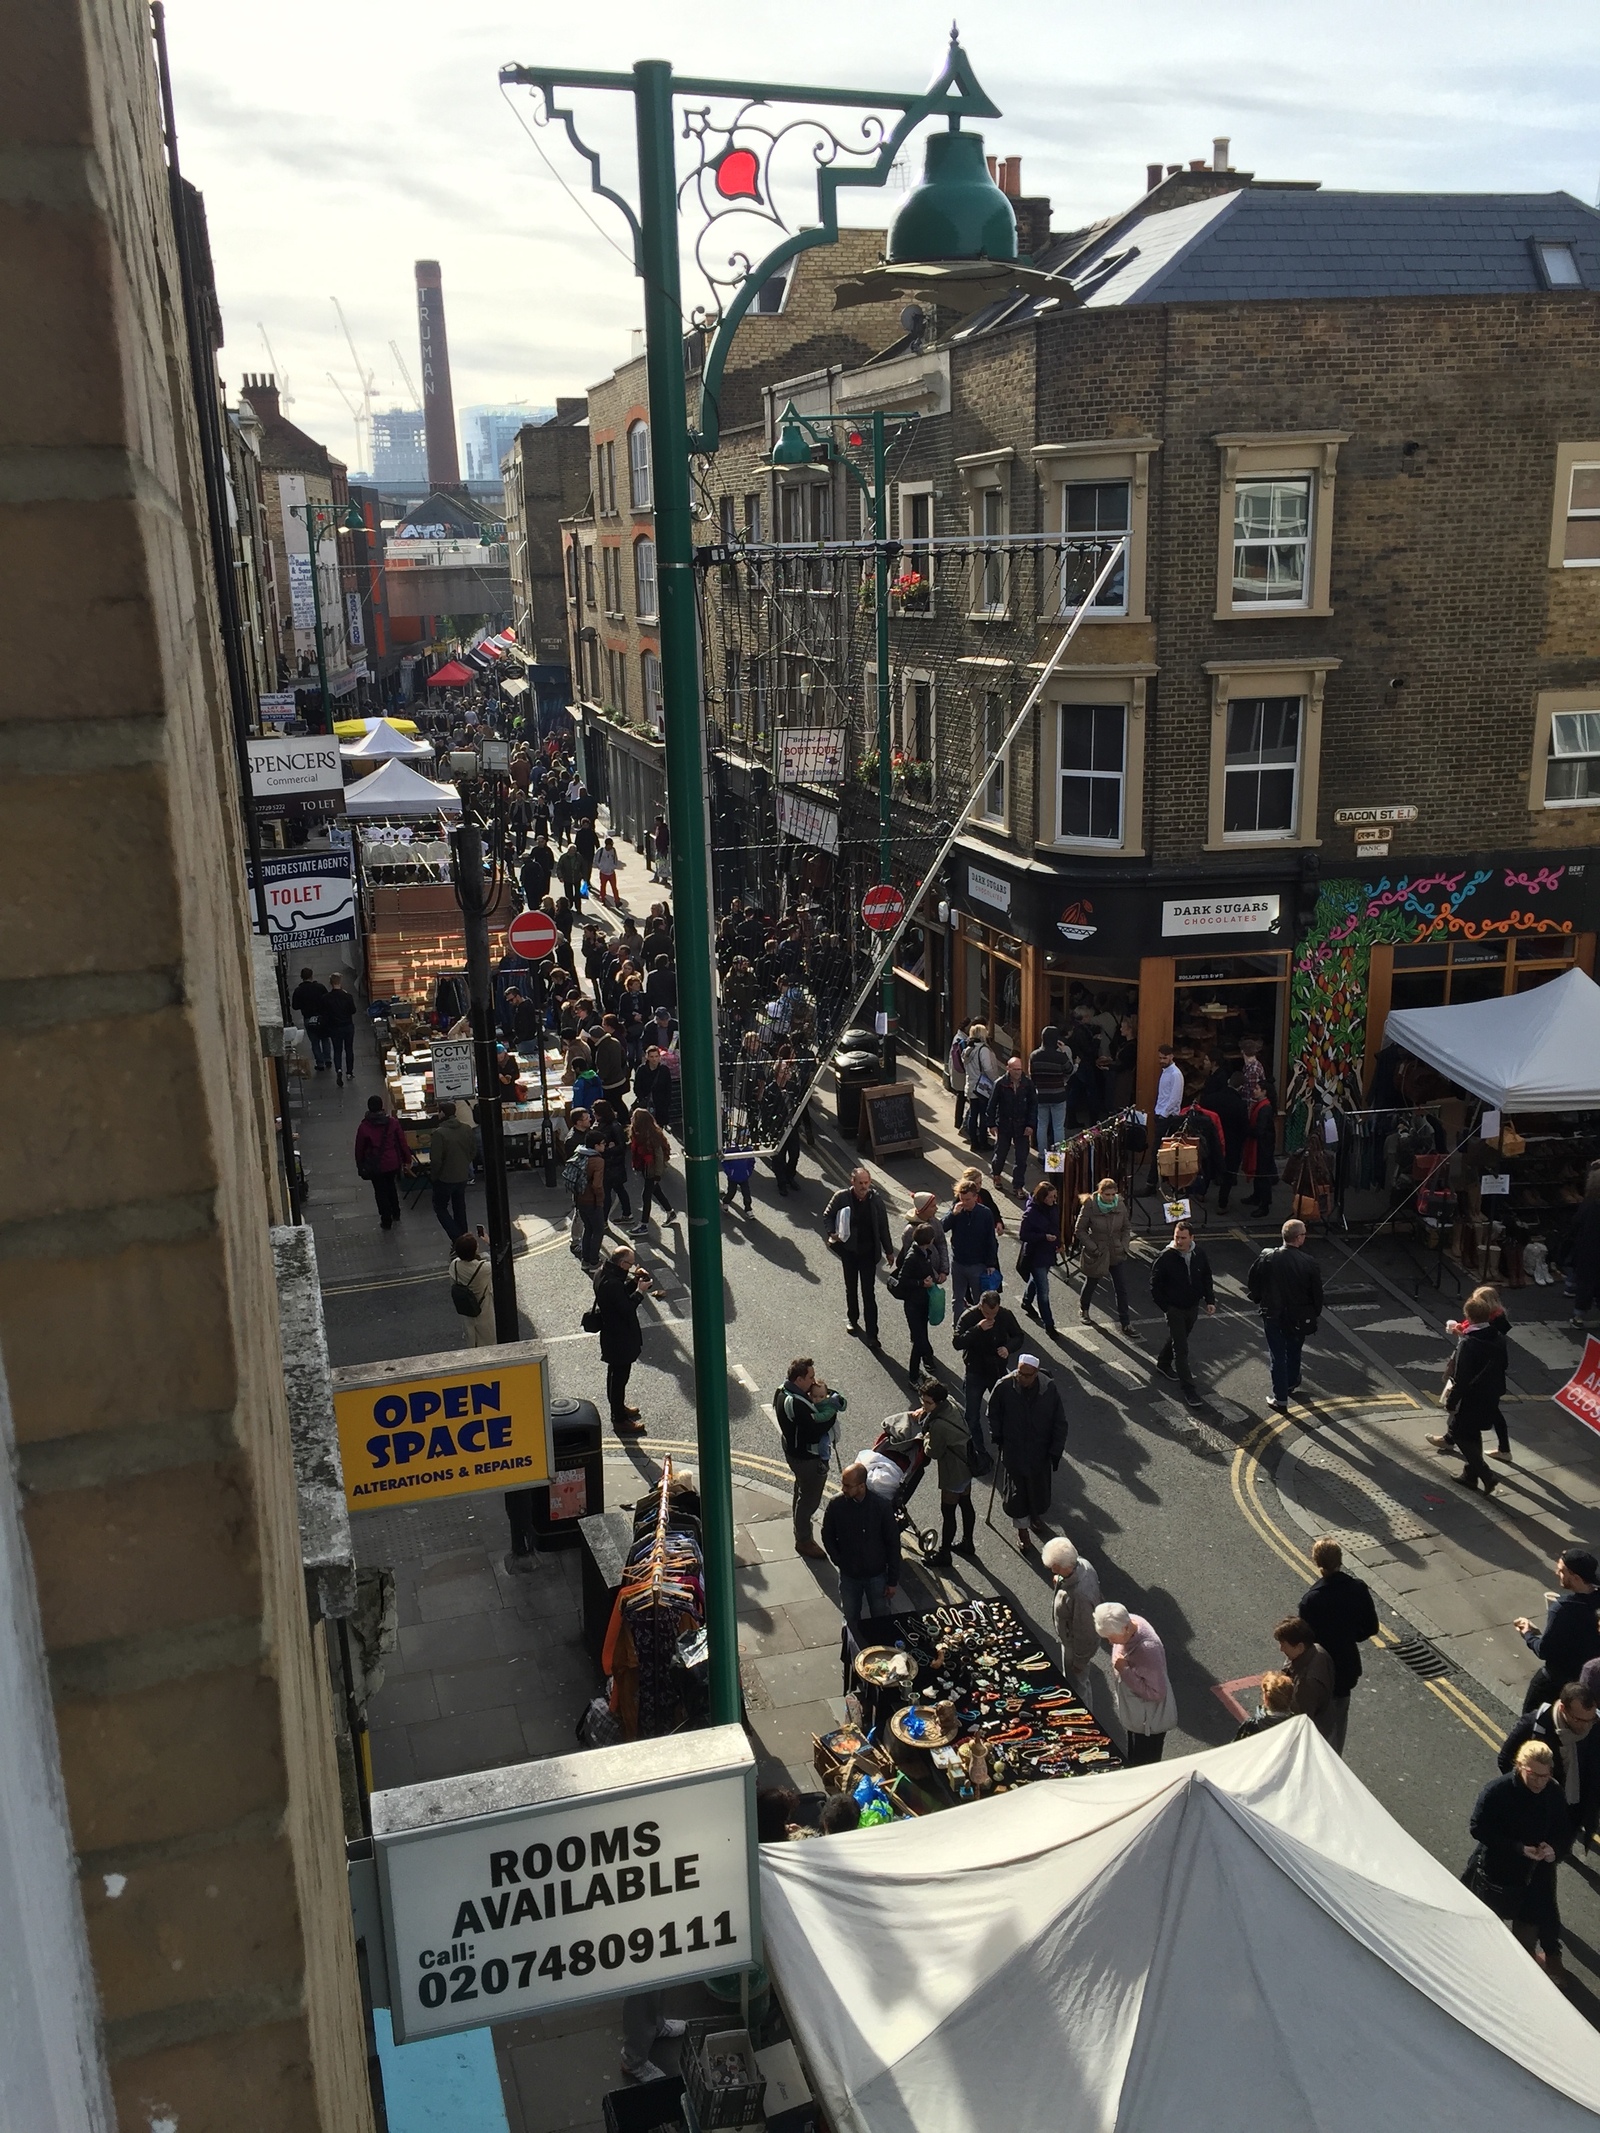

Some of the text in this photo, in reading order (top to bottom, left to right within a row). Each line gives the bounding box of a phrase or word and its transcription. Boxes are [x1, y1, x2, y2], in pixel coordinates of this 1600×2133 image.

[418, 287, 435, 395] TRUMAN
[266, 773, 318, 786] Commercial
[300, 799, 336, 810] TO LET
[1340, 811, 1377, 822] BACON
[317, 856, 349, 870] AGENTS
[971, 872, 1007, 895] DARK SUGARS
[975, 885, 1003, 902] CHOCOLATES
[1174, 902, 1268, 917] DARK SUGARS
[1184, 915, 1257, 926] CHOCOLATES
[434, 1045, 469, 1057] CCTV
[373, 1380, 501, 1429] OPEN
[366, 1415, 512, 1469] SPACE
[352, 1455, 533, 1497] ALTERATIONS & REPAIRS
[490, 1820, 661, 1888] ROOMS
[452, 1853, 700, 1939] AVAILABLE
[418, 1942, 476, 1970] Call:
[418, 1910, 738, 2009] 02074809111
